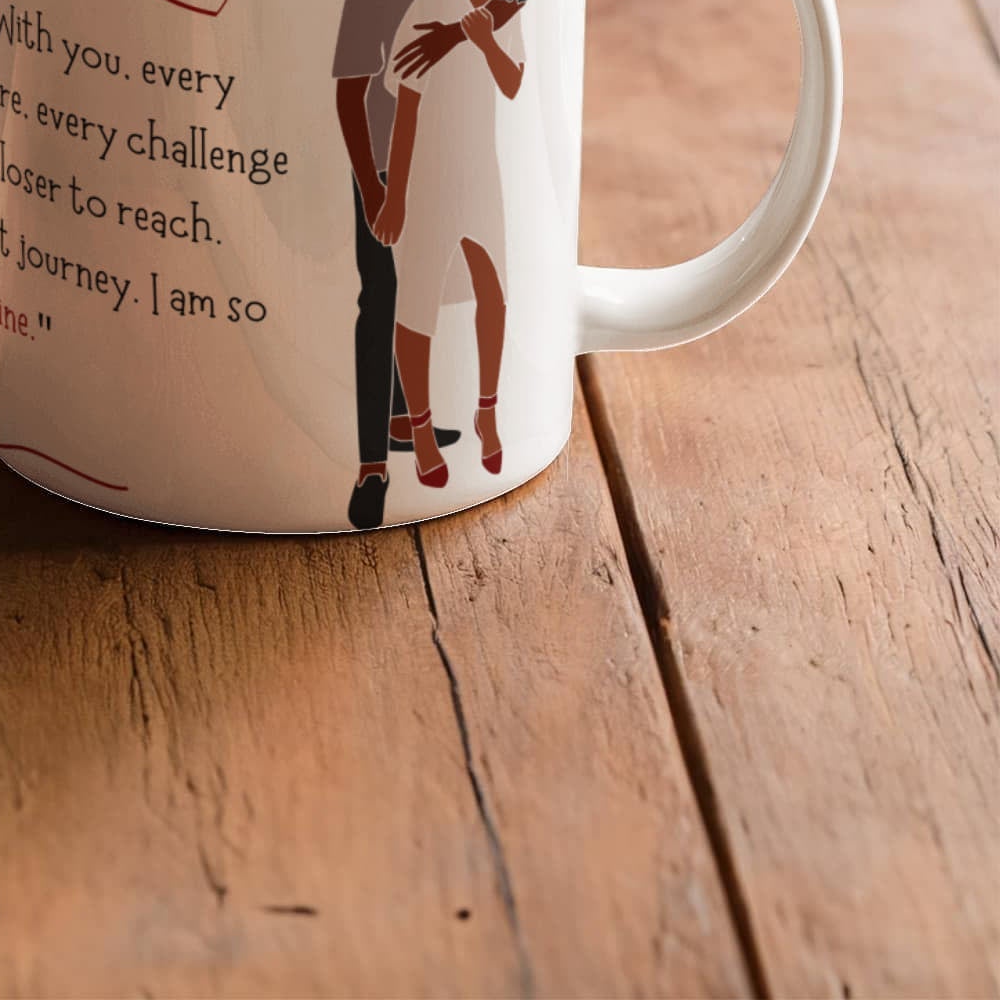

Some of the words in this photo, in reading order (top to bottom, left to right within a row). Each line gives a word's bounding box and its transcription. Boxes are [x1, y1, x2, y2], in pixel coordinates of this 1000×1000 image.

[142, 60, 235, 111] every
[37, 101, 118, 160] every
[127, 118, 289, 185] challenge
[68, 175, 107, 217] to
[117, 200, 222, 246] reach.
[17, 234, 139, 312] journey.
[151, 272, 159, 316] I
[169, 288, 216, 319] am
[227, 296, 267, 323] so
